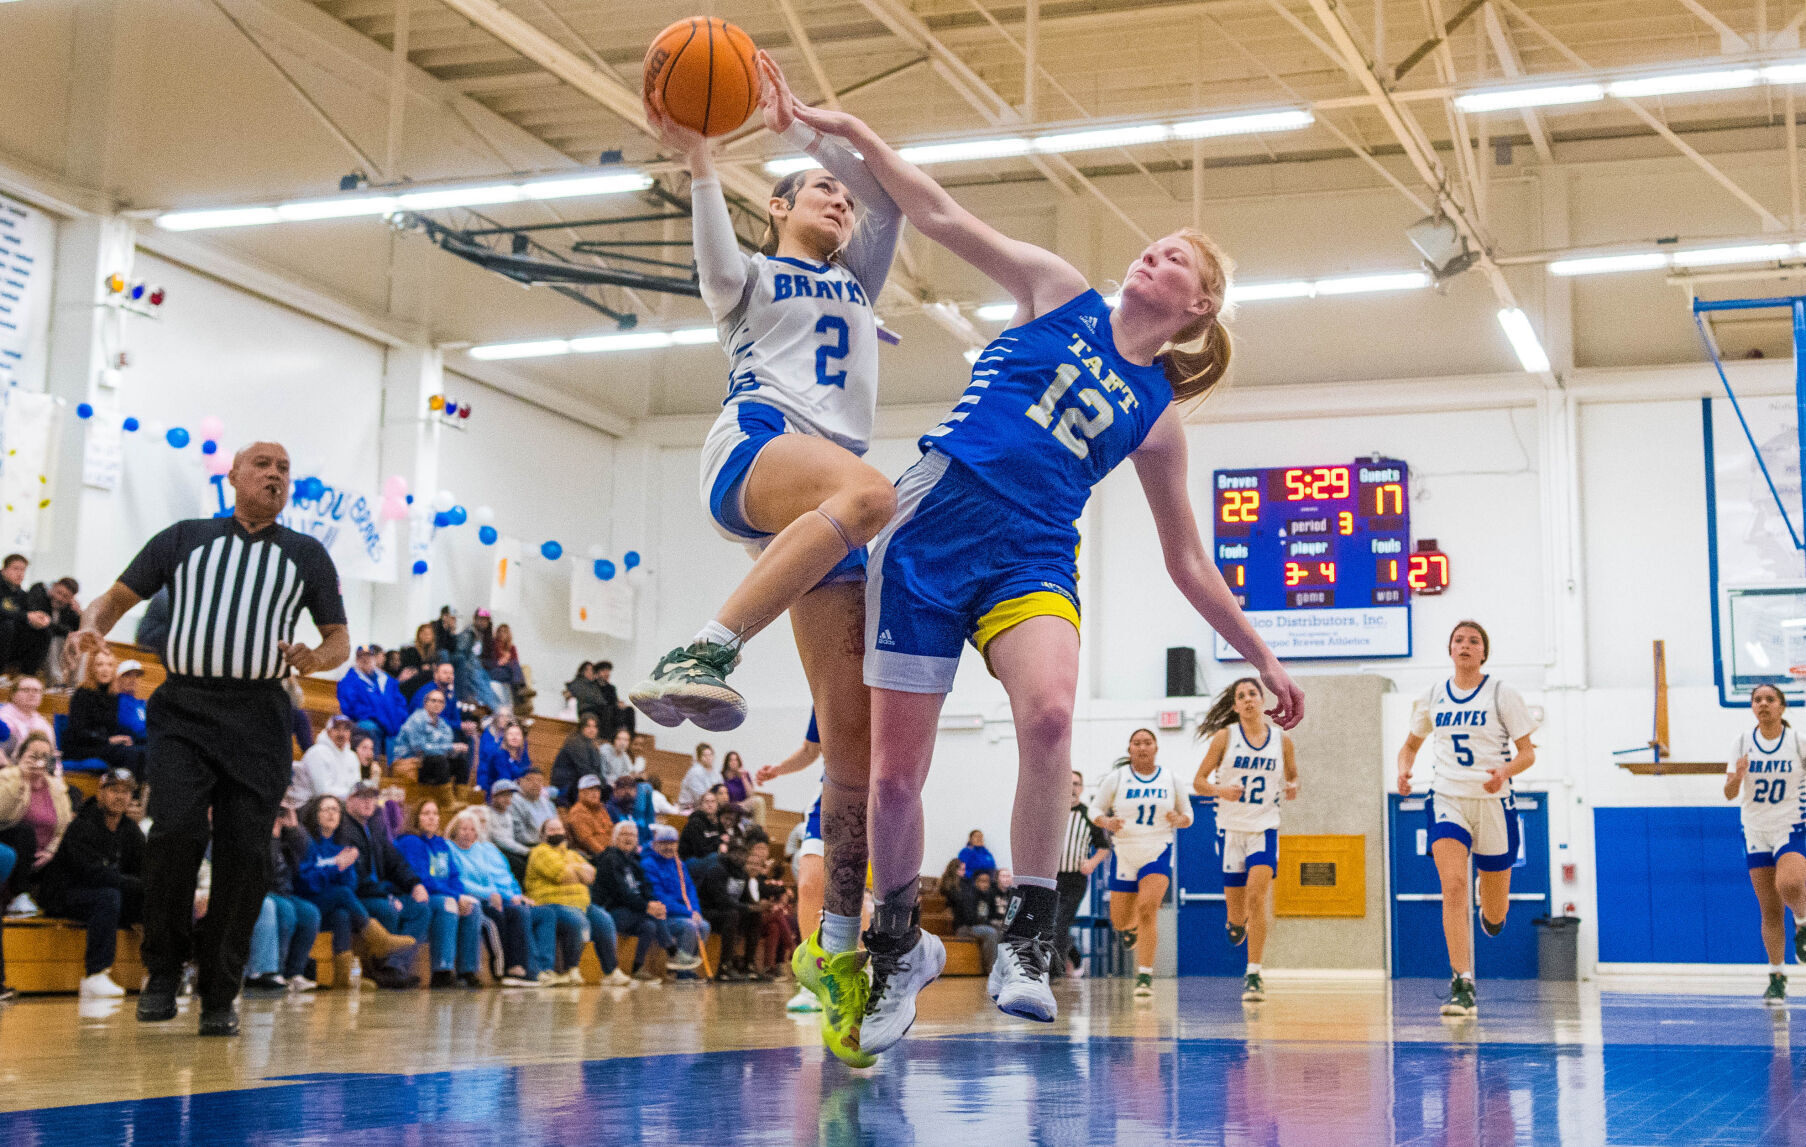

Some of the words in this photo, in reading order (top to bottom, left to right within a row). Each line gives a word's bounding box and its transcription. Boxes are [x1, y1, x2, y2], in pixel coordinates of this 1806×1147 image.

[815, 314, 849, 390] 2
[1067, 333, 1140, 415] TAFT
[1024, 362, 1114, 461] 12
[1218, 474, 1259, 490] Braves
[1285, 467, 1350, 501] 5:29
[1359, 467, 1401, 483] Guests
[1221, 490, 1260, 523] 22
[1375, 484, 1403, 516] 17
[1290, 518, 1328, 536] period
[1338, 511, 1354, 536] 3
[1218, 544, 1249, 560] fouls
[1289, 541, 1329, 557] player
[1371, 538, 1402, 554] fouls
[1235, 564, 1246, 587] 1
[1318, 561, 1336, 584] 4
[1388, 559, 1398, 583] 1
[1407, 554, 1449, 589] 27
[1376, 590, 1400, 603] won
[1362, 613, 1388, 627] Inc.
[1434, 710, 1488, 728] BRAVES
[1451, 733, 1475, 767] 5
[1233, 755, 1277, 771] BRAVES
[1748, 759, 1793, 774] BRAVES
[1125, 788, 1168, 800] BRAVES
[1238, 775, 1266, 805] 12
[1752, 778, 1787, 805] 20
[1135, 804, 1157, 826] 11
